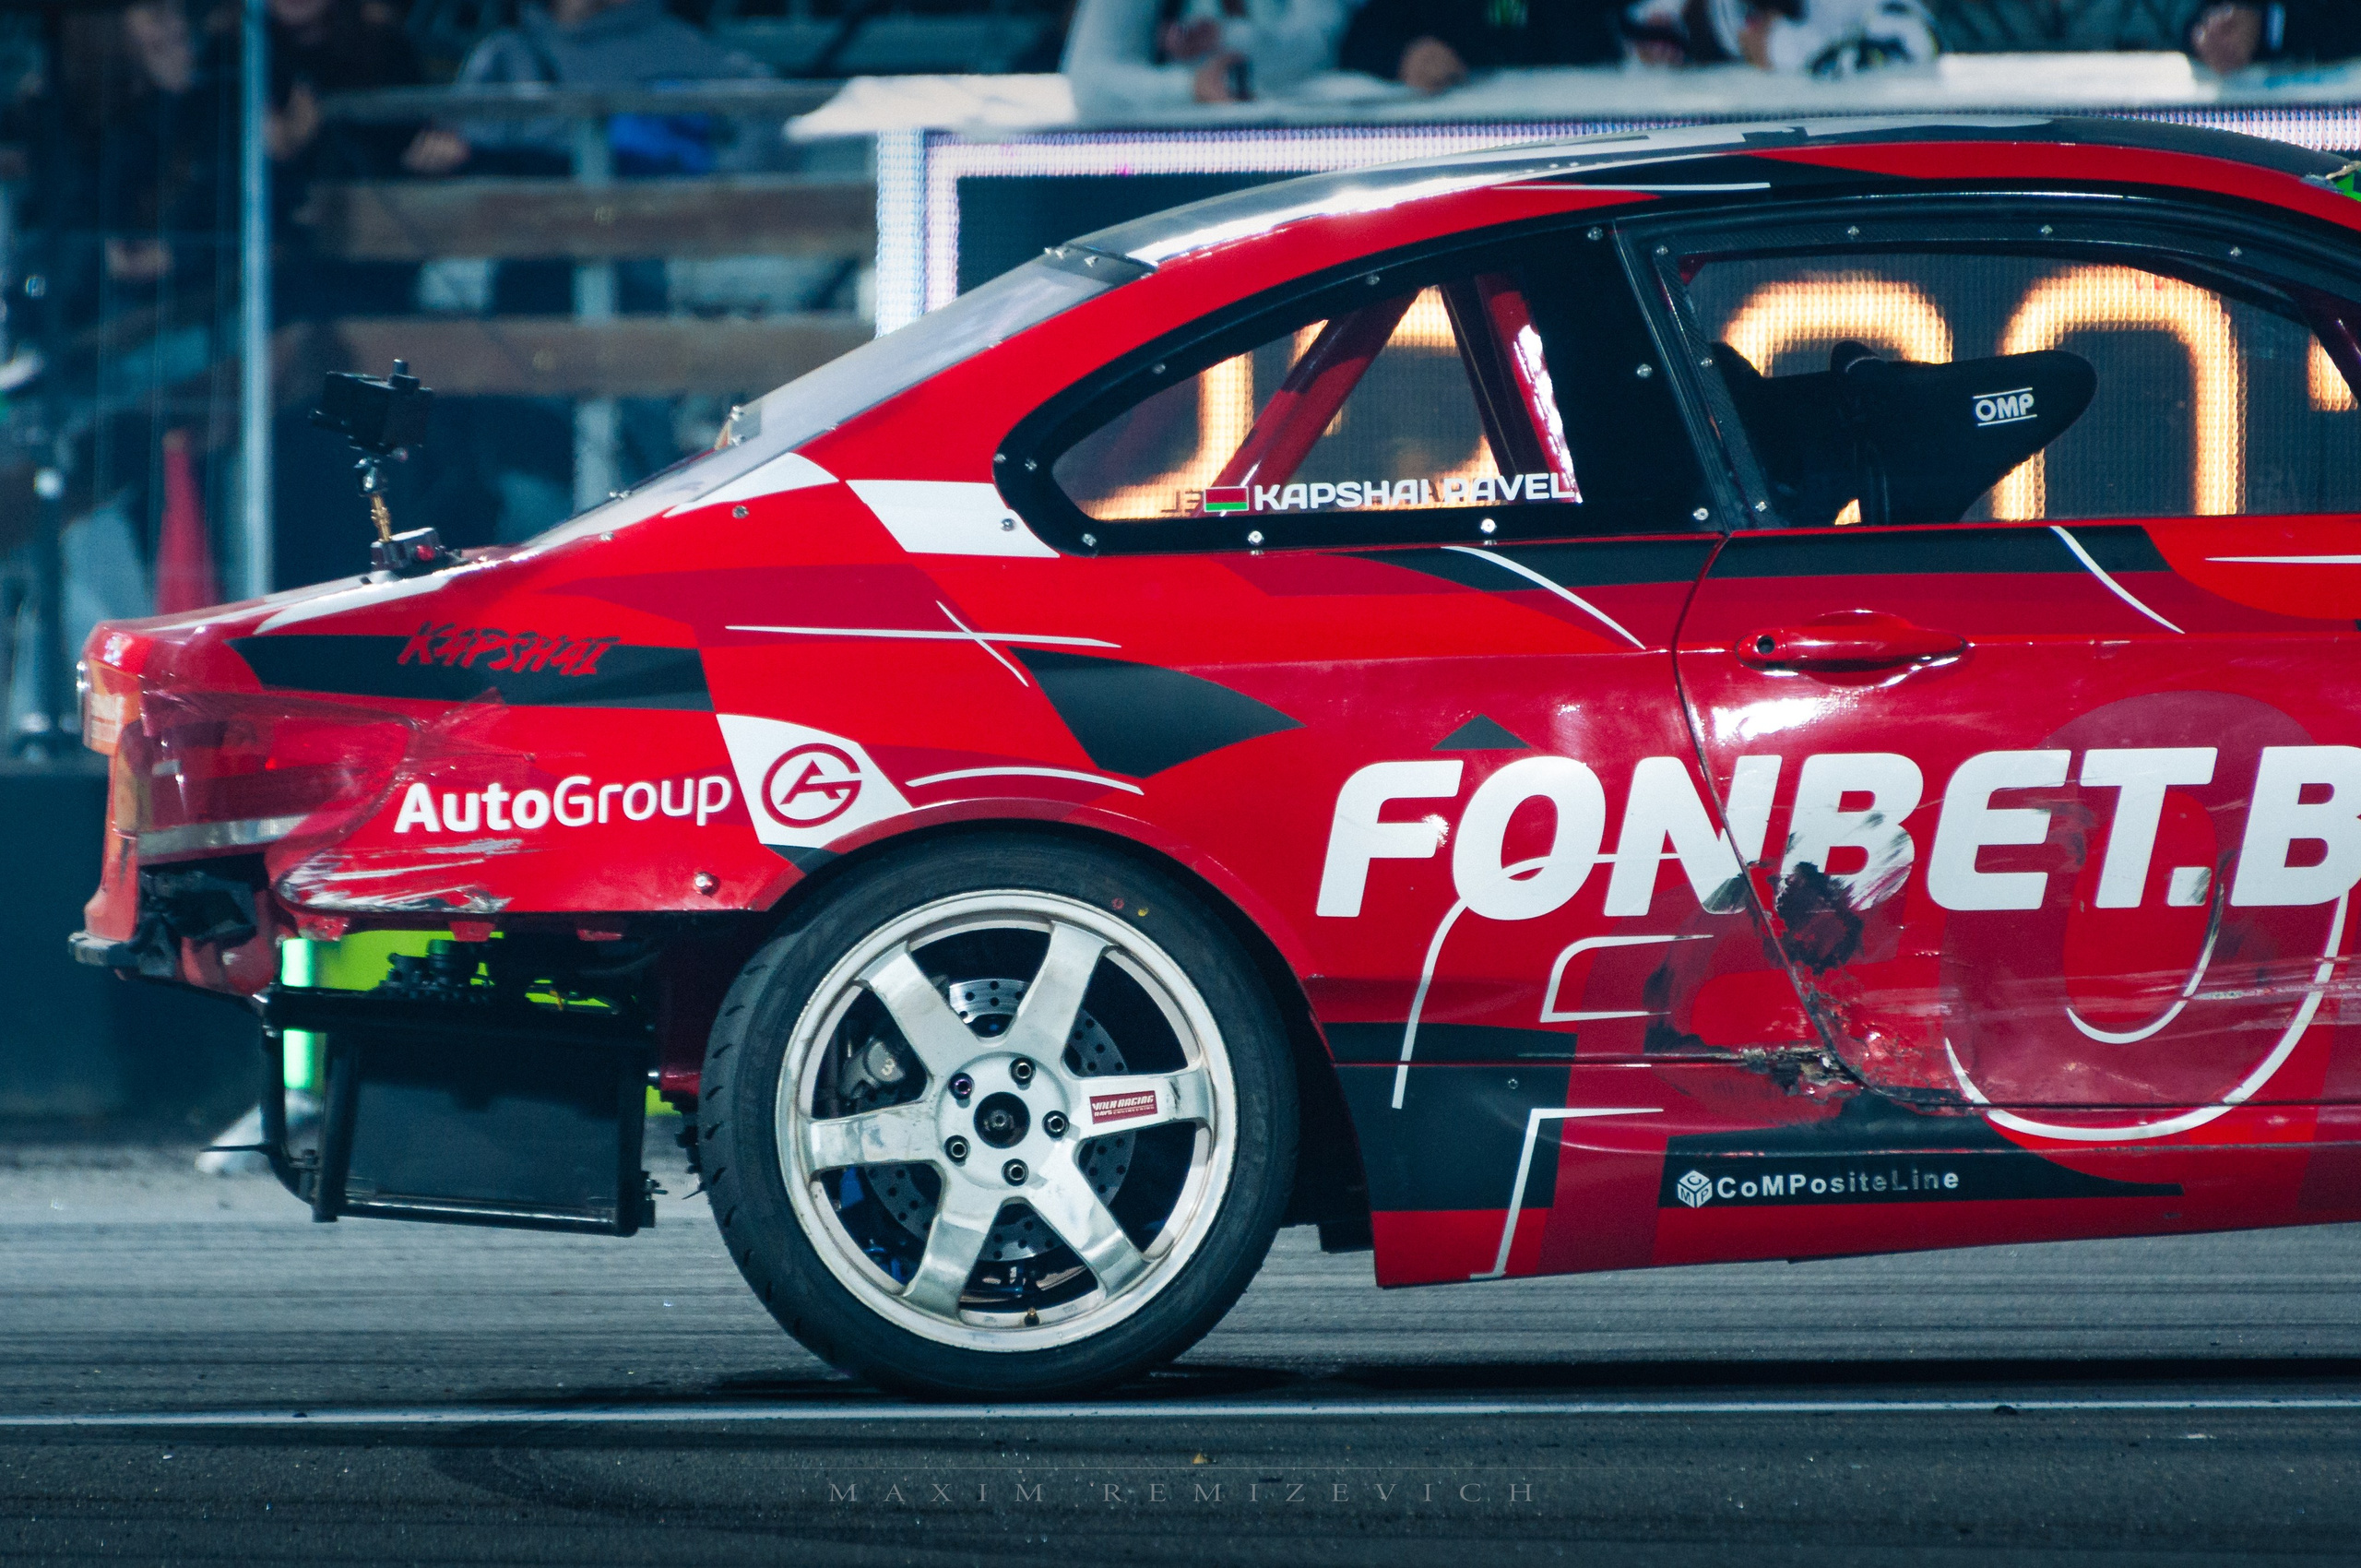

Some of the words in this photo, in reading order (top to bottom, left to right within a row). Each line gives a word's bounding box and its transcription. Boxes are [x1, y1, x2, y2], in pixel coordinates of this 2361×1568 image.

[1975, 393, 2035, 422] OMP
[1254, 478, 1430, 511] KAPSHAI
[1443, 472, 1575, 504] PAVEL
[397, 620, 622, 677] KAPSHAI
[394, 775, 732, 833] AutoGroup
